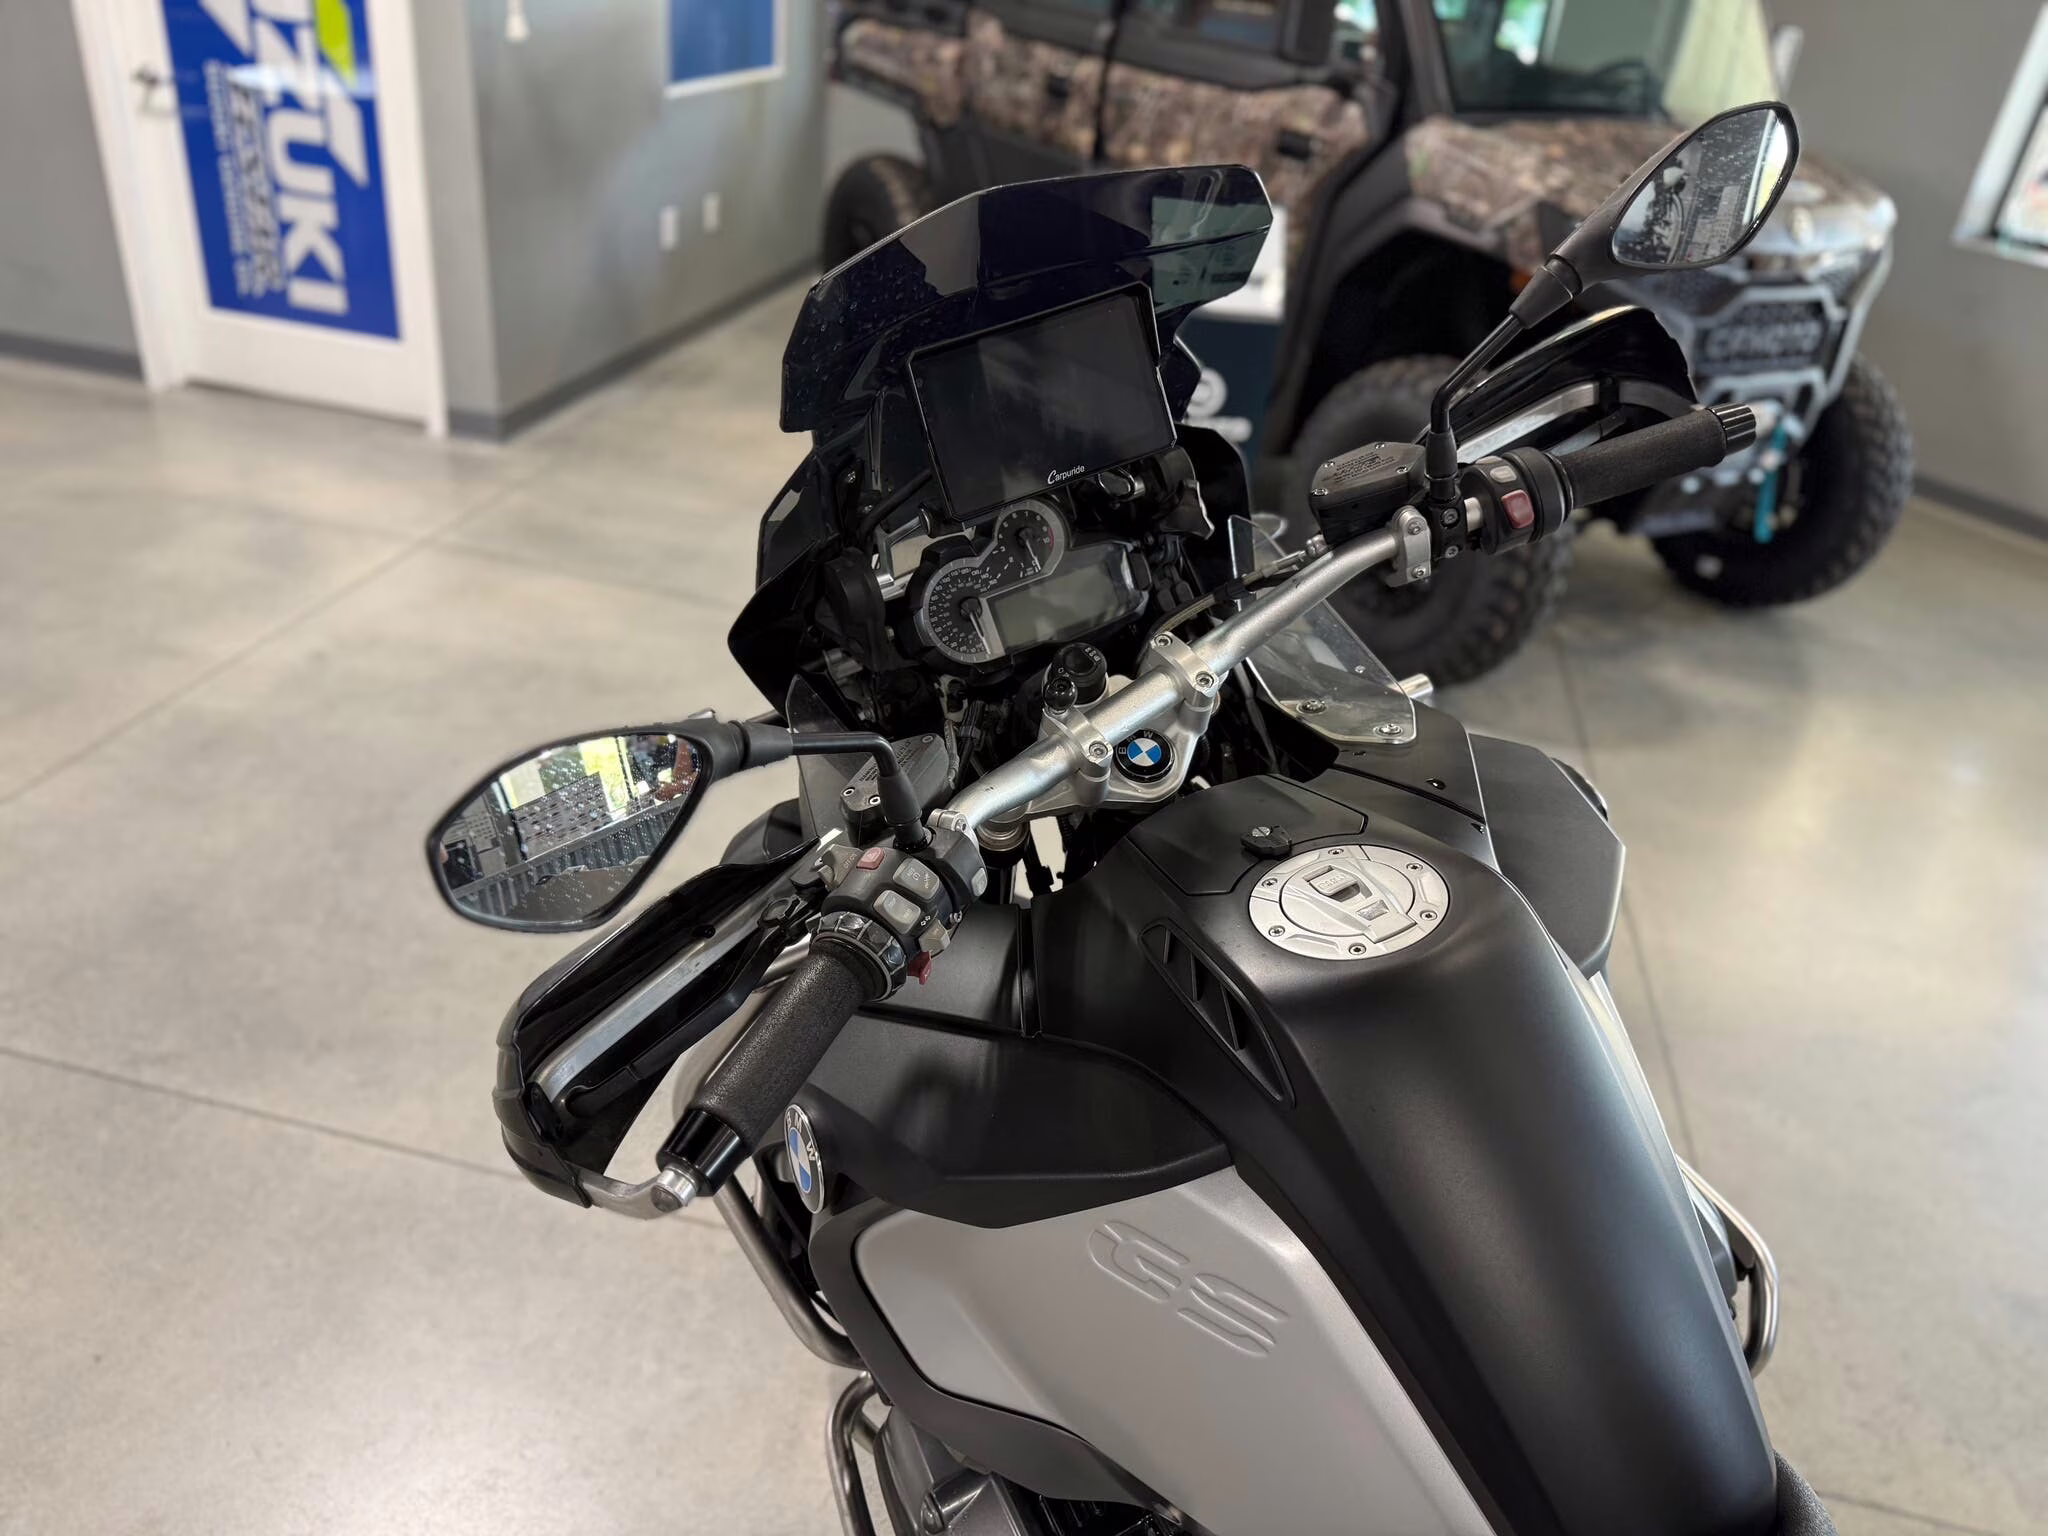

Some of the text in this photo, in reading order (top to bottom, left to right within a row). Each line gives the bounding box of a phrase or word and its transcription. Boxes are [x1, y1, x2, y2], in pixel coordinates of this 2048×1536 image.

[1047, 465, 1085, 485] Carpuride
[786, 1111, 816, 1161] BMW
[1087, 1219, 1290, 1357] GS
